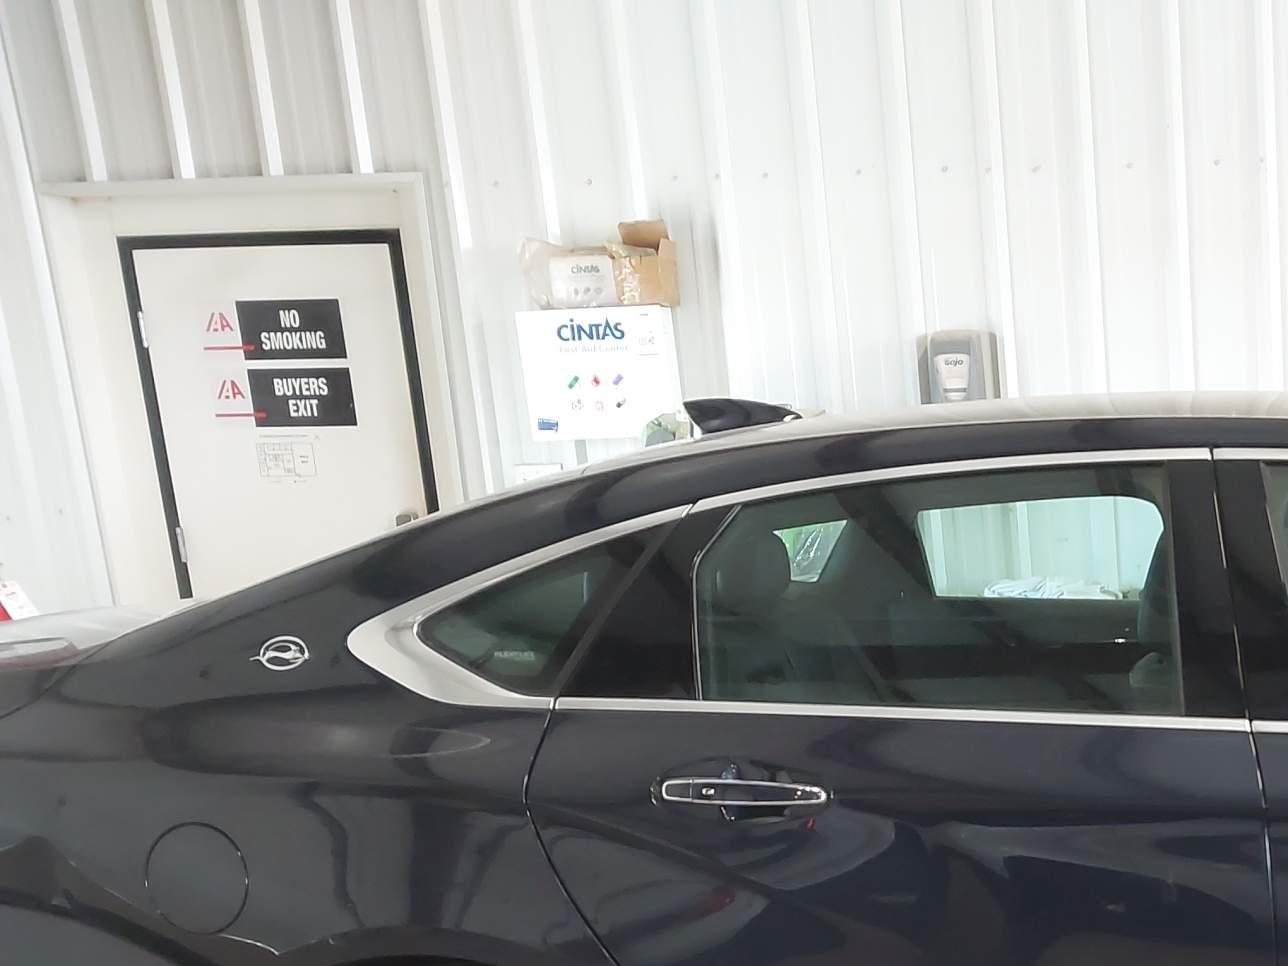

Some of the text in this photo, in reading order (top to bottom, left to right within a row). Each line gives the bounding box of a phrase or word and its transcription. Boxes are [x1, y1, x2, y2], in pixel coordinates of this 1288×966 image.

[279, 310, 300, 328] NO
[260, 331, 326, 350] SMOKING
[273, 377, 328, 396] BUYERS
[288, 399, 319, 417] EXIT
